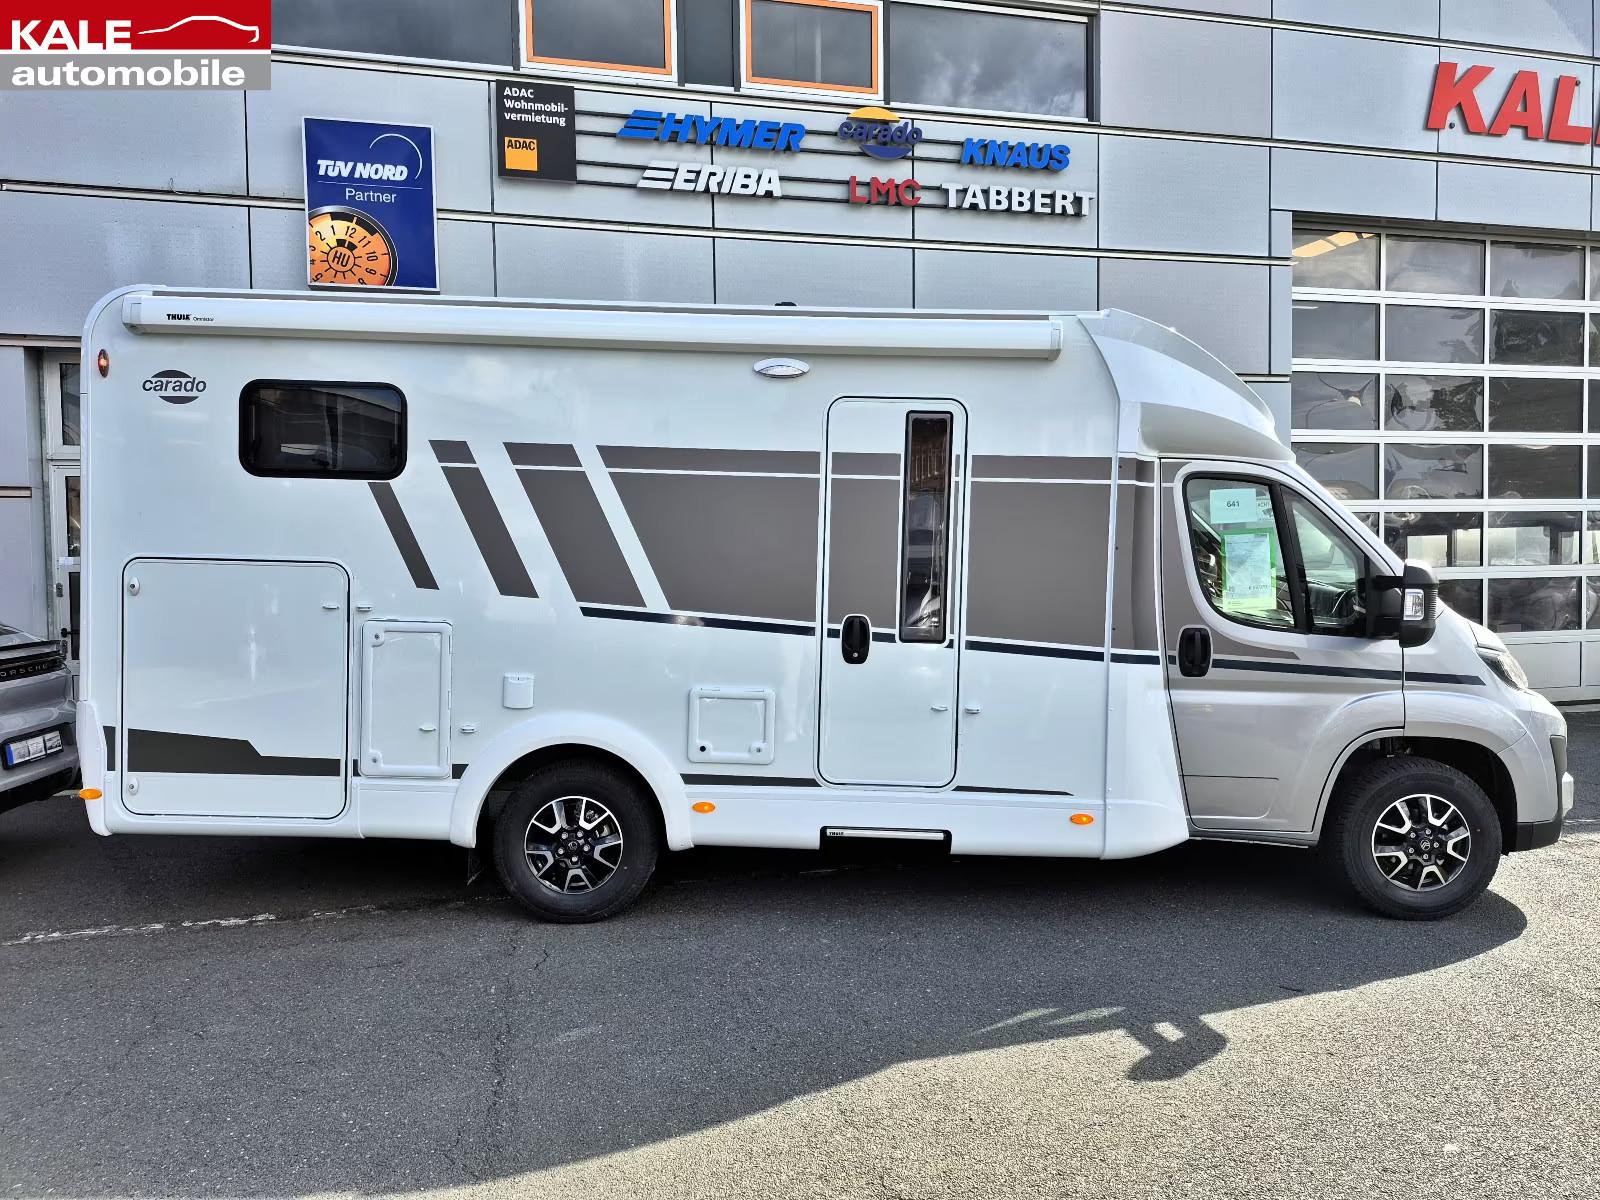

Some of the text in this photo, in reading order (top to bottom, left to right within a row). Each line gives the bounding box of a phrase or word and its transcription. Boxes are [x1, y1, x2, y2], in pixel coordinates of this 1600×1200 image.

[503, 87, 535, 98] ADAC
[503, 98, 569, 113] Wohnmobil-
[1427, 61, 1600, 146] KAL
[504, 112, 567, 127] vermietung
[658, 112, 806, 151] HYMER
[838, 121, 923, 145] carado
[506, 139, 536, 151] ADAC
[962, 137, 1071, 171] KNAUS
[354, 162, 408, 181] NORD
[672, 162, 782, 198] ERIBA
[345, 188, 397, 203] Partner
[849, 175, 922, 207] LMC
[940, 182, 1095, 217] TABBERT
[315, 231, 326, 241] 2
[345, 226, 357, 238] 12
[332, 250, 350, 267] HU
[366, 251, 378, 261] 10
[142, 377, 207, 392] carado
